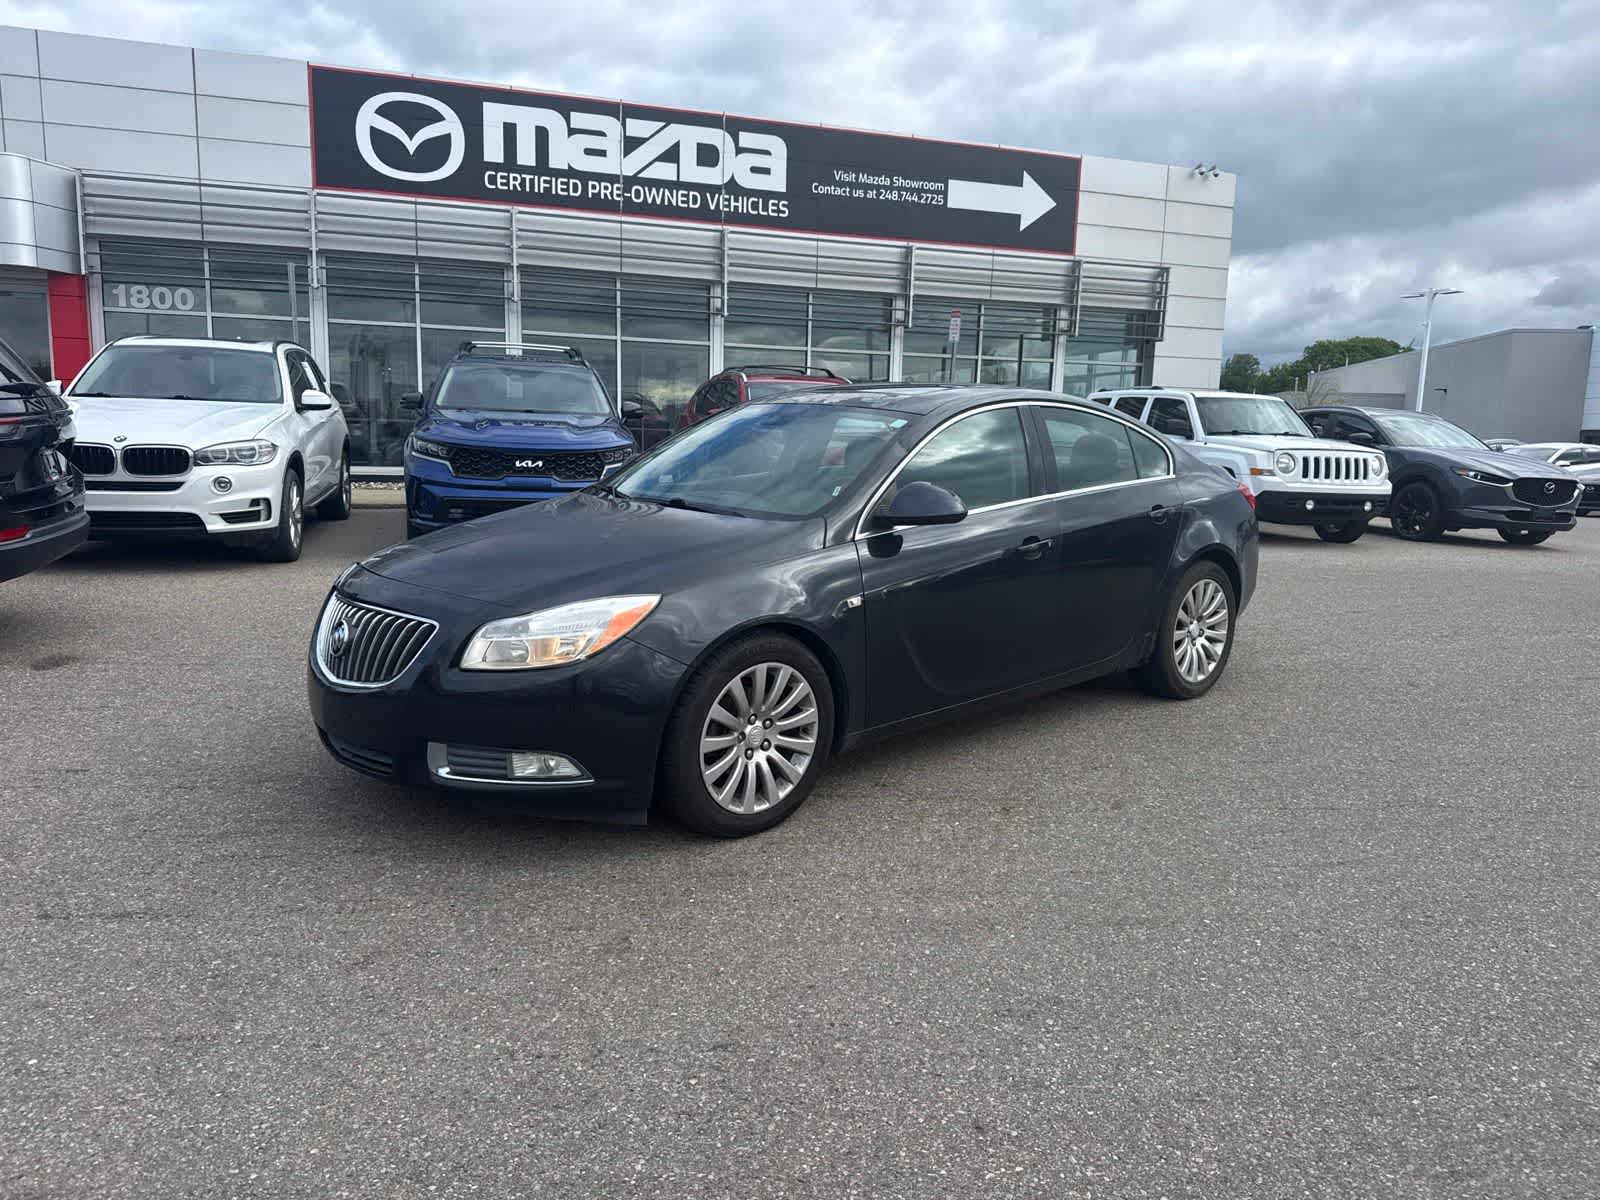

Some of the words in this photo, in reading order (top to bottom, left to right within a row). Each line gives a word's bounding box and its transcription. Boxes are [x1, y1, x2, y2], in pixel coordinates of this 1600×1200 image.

[834, 170, 856, 182] Visit
[859, 172, 890, 186] Mazda
[893, 176, 944, 191] Showroom
[484, 171, 582, 197] CERTIFIED
[588, 181, 701, 208] PRE-OWNED
[707, 193, 789, 217] VEHICLES
[812, 182, 850, 196] Contact
[852, 189, 864, 198] us
[867, 189, 877, 199] at
[880, 189, 944, 205] 248.744.2725
[112, 284, 195, 311] 1800
[515, 459, 543, 468] KIA
